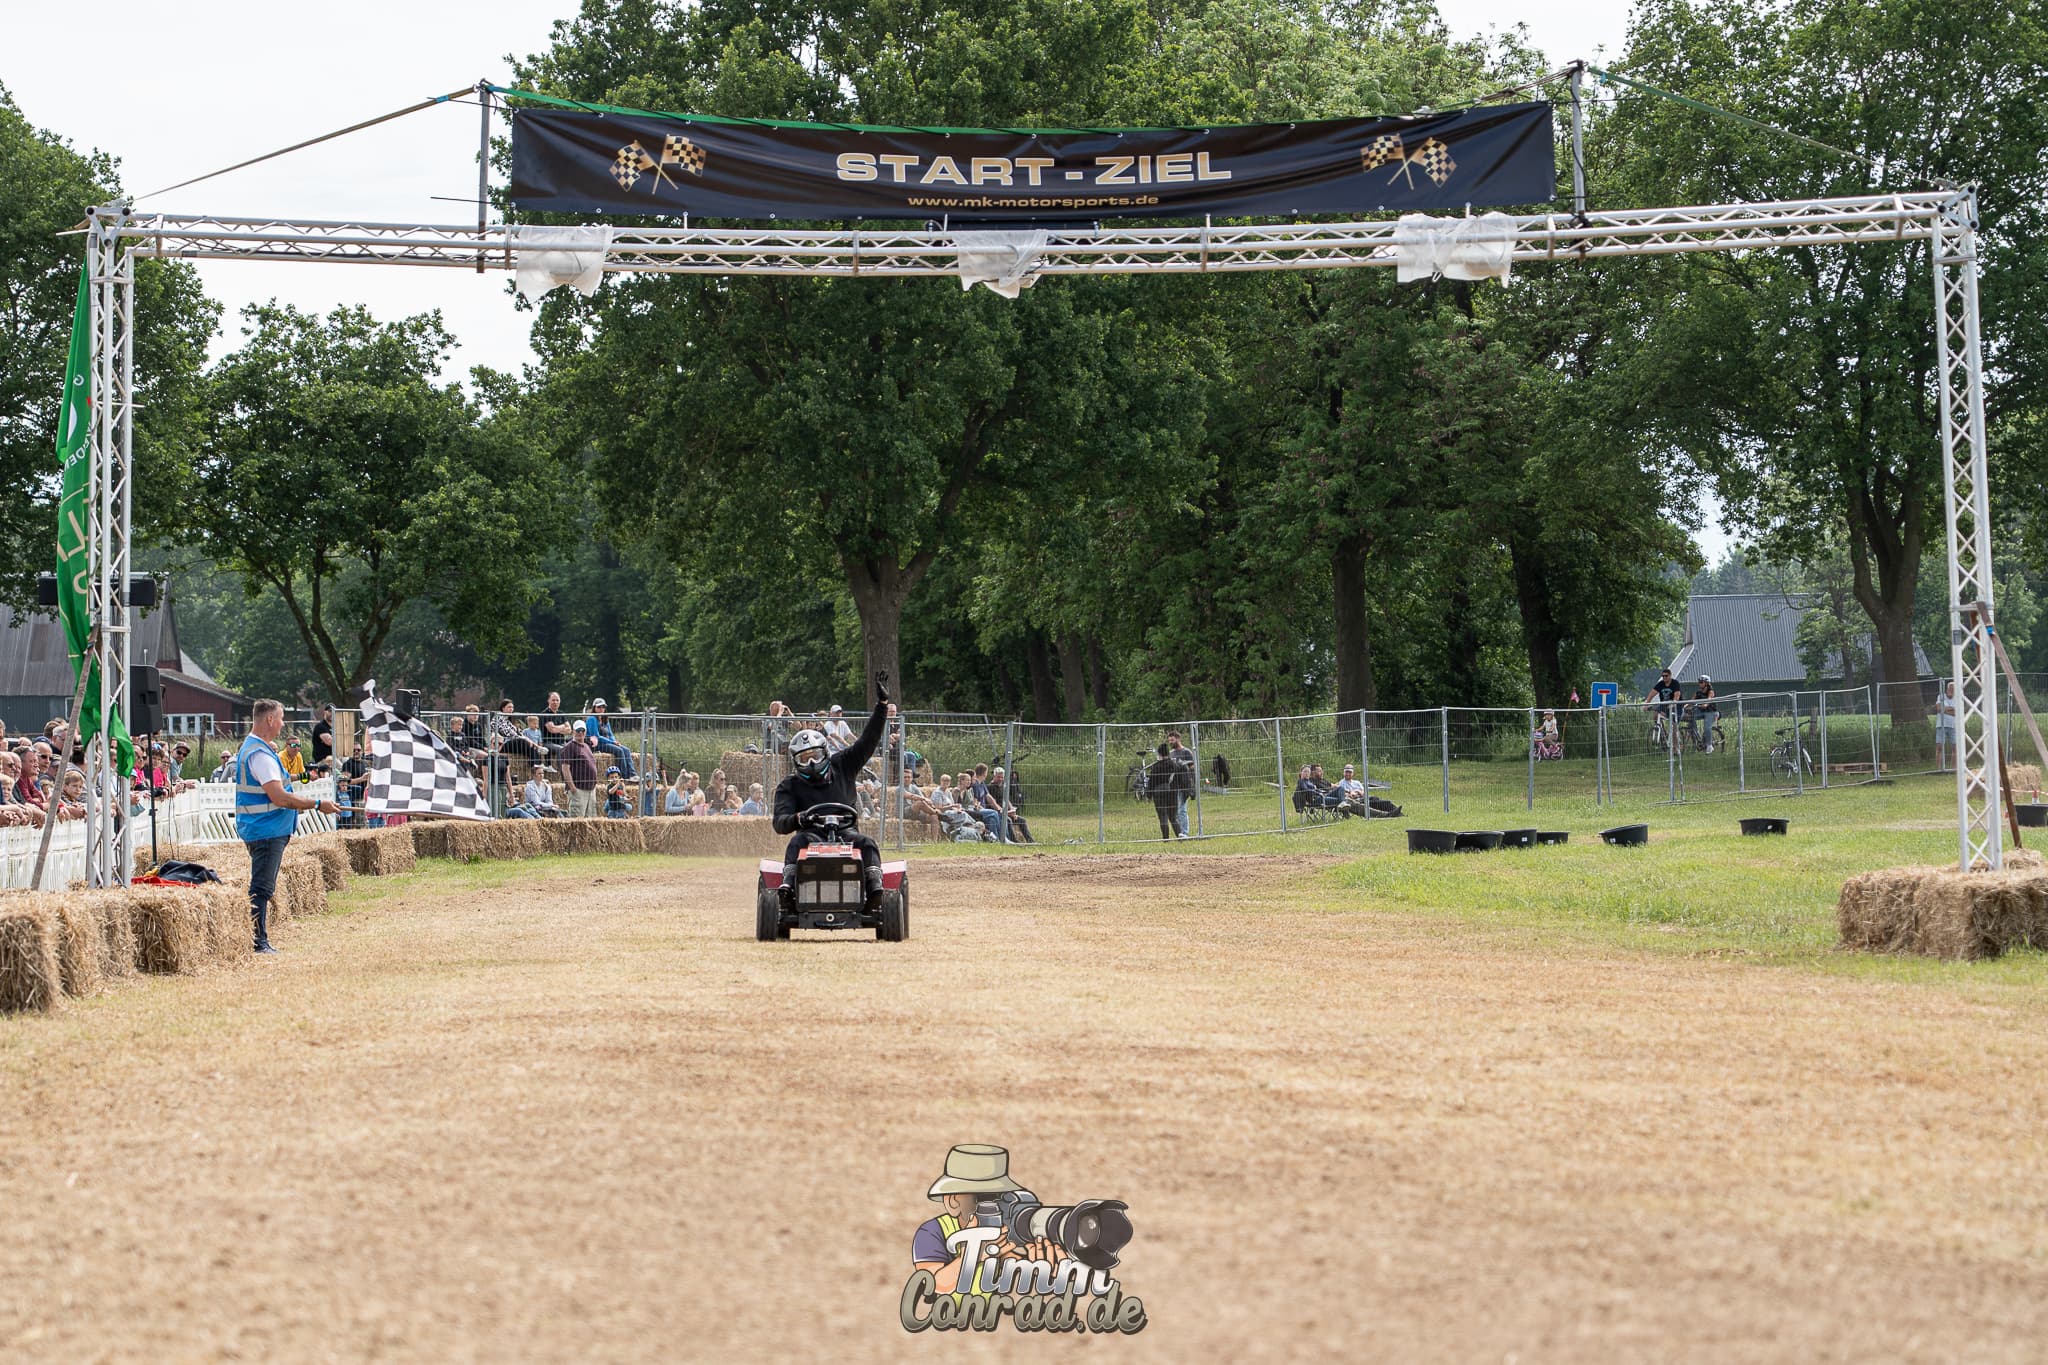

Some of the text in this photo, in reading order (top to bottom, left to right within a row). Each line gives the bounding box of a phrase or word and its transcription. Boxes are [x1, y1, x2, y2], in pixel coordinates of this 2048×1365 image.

[836, 152, 1055, 186] START
[1095, 151, 1232, 185] ZIEL
[907, 194, 1160, 209] www.mk-motorsports.de
